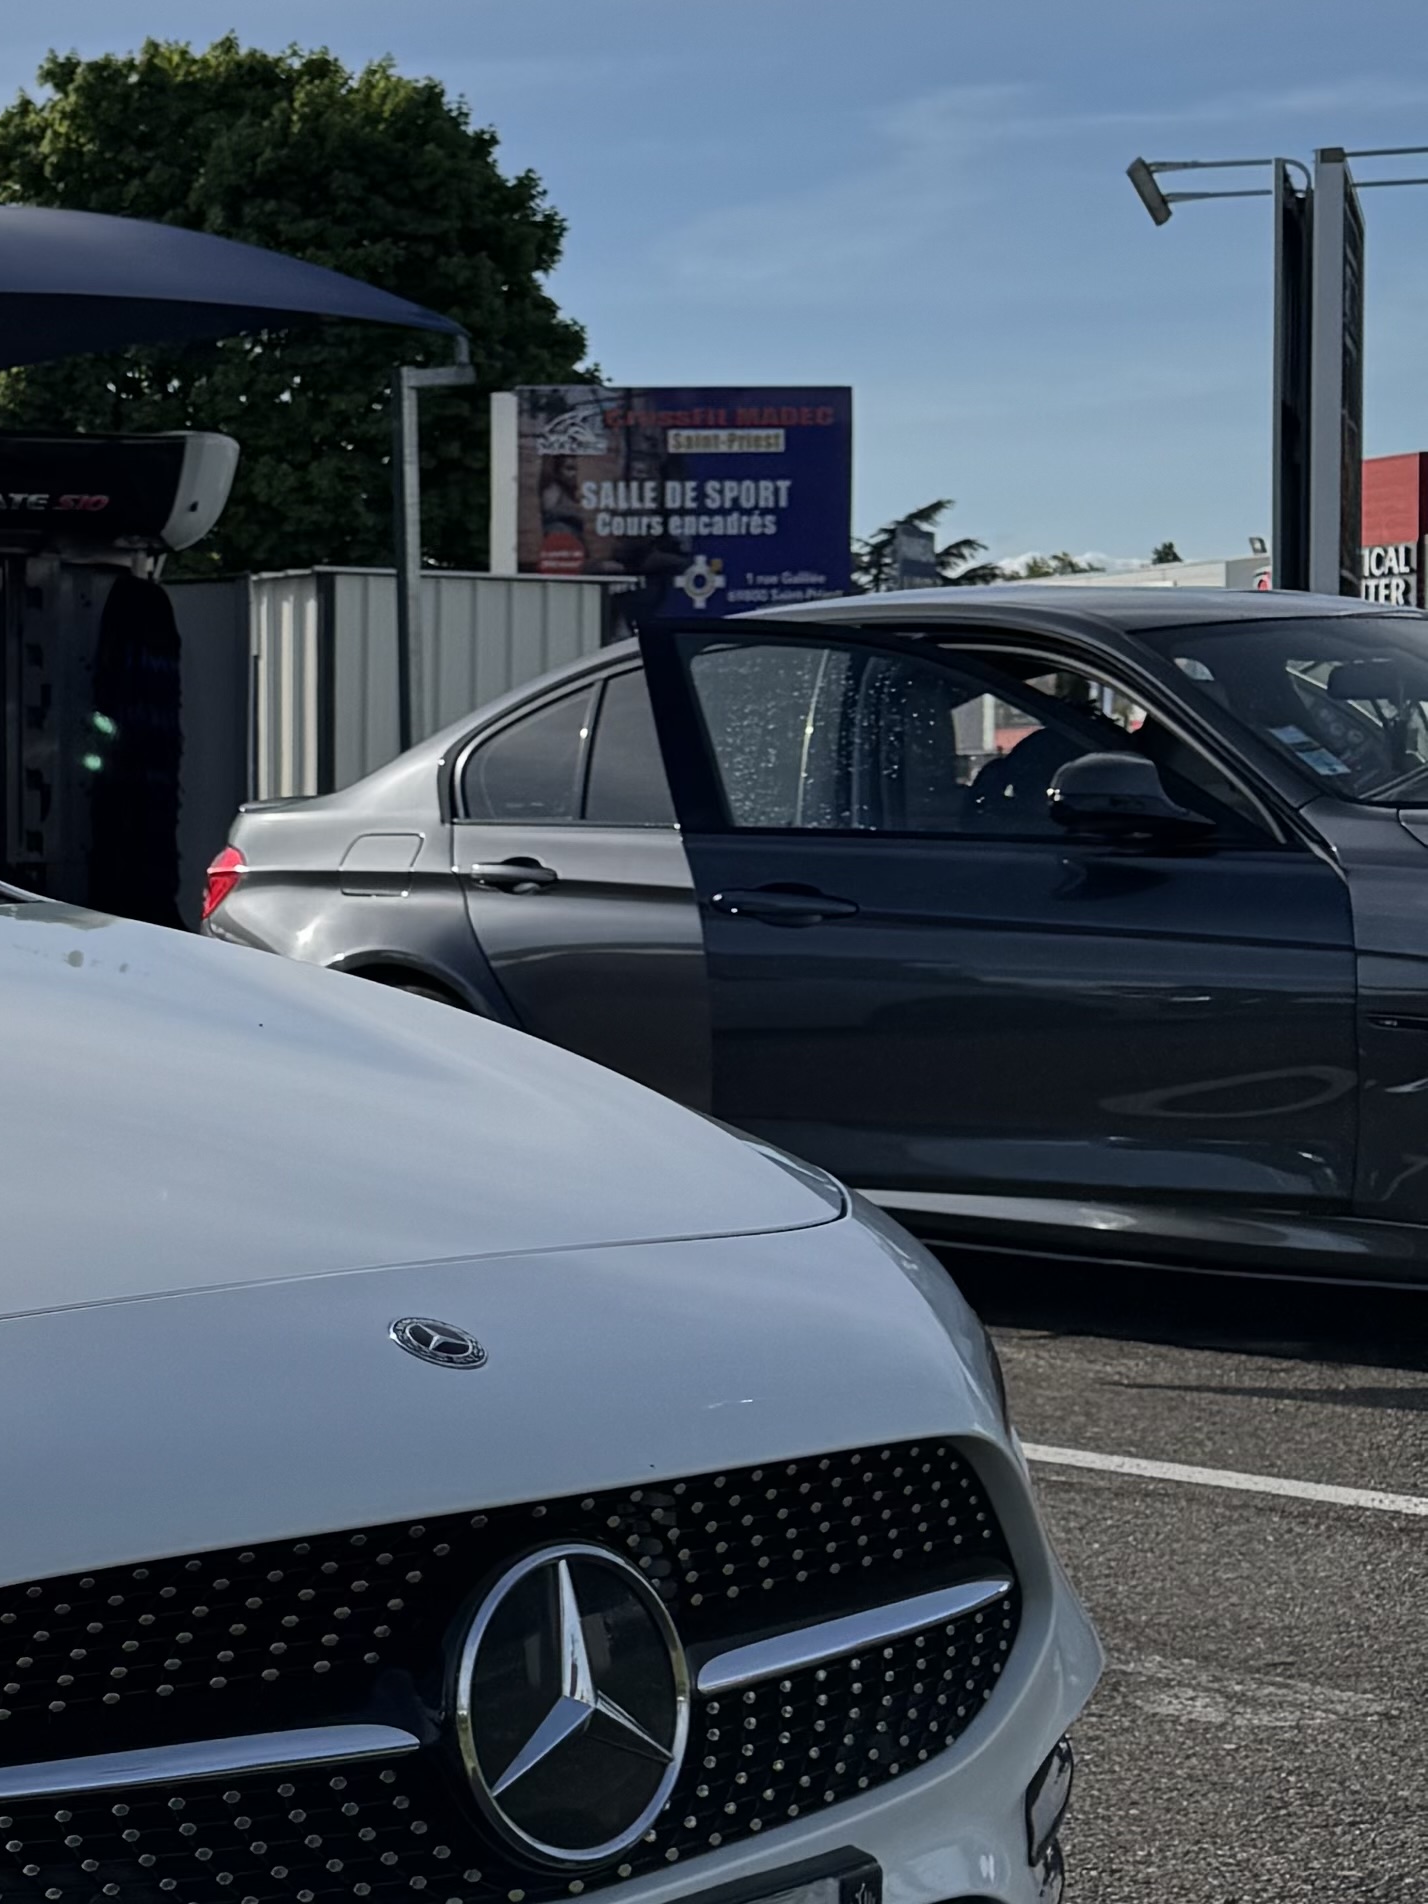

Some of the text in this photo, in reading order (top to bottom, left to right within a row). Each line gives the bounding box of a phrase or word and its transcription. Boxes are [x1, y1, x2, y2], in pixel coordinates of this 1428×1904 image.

[736, 405, 835, 426] MADEC
[581, 479, 792, 510] SALLE DE SPORT
[595, 512, 777, 537] Cours encadrés
[1362, 544, 1410, 576] ICAL
